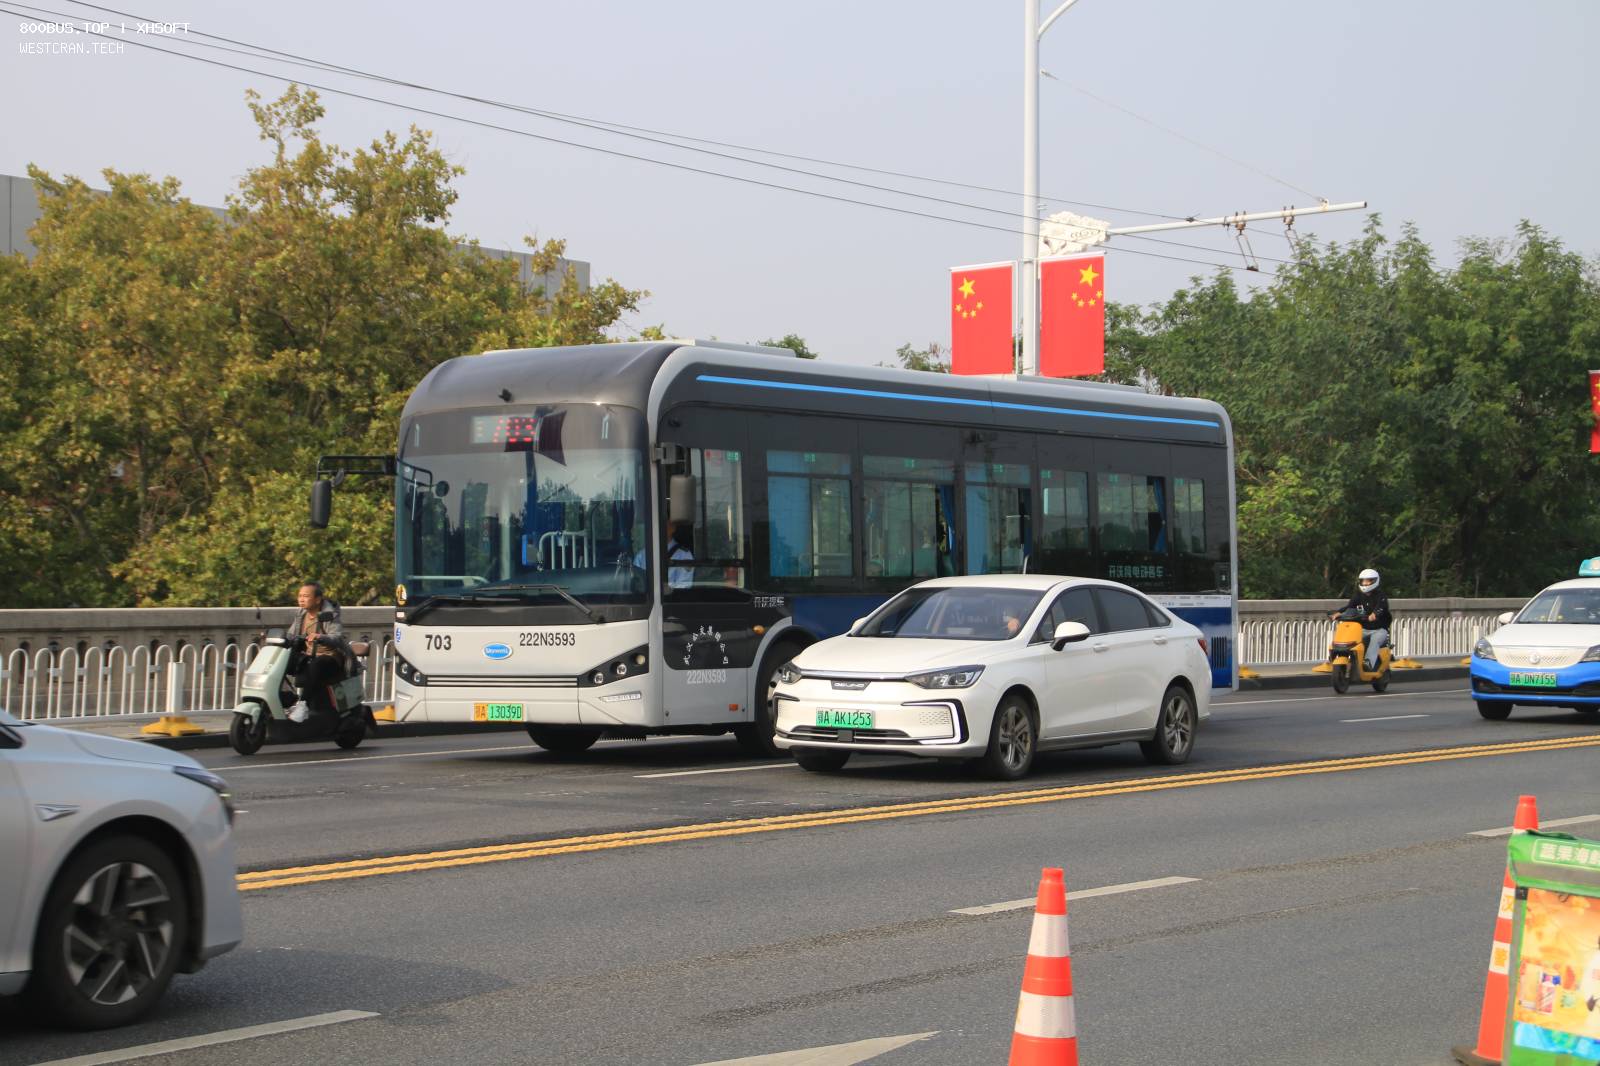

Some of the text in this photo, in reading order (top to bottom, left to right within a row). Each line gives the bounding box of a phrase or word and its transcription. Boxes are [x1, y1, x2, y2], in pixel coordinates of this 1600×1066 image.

[425, 634, 452, 651] 703
[520, 632, 576, 647] 222N3593
[686, 670, 727, 685] 222N3593
[490, 705, 522, 719] 13039D
[834, 711, 872, 726] AK1253
